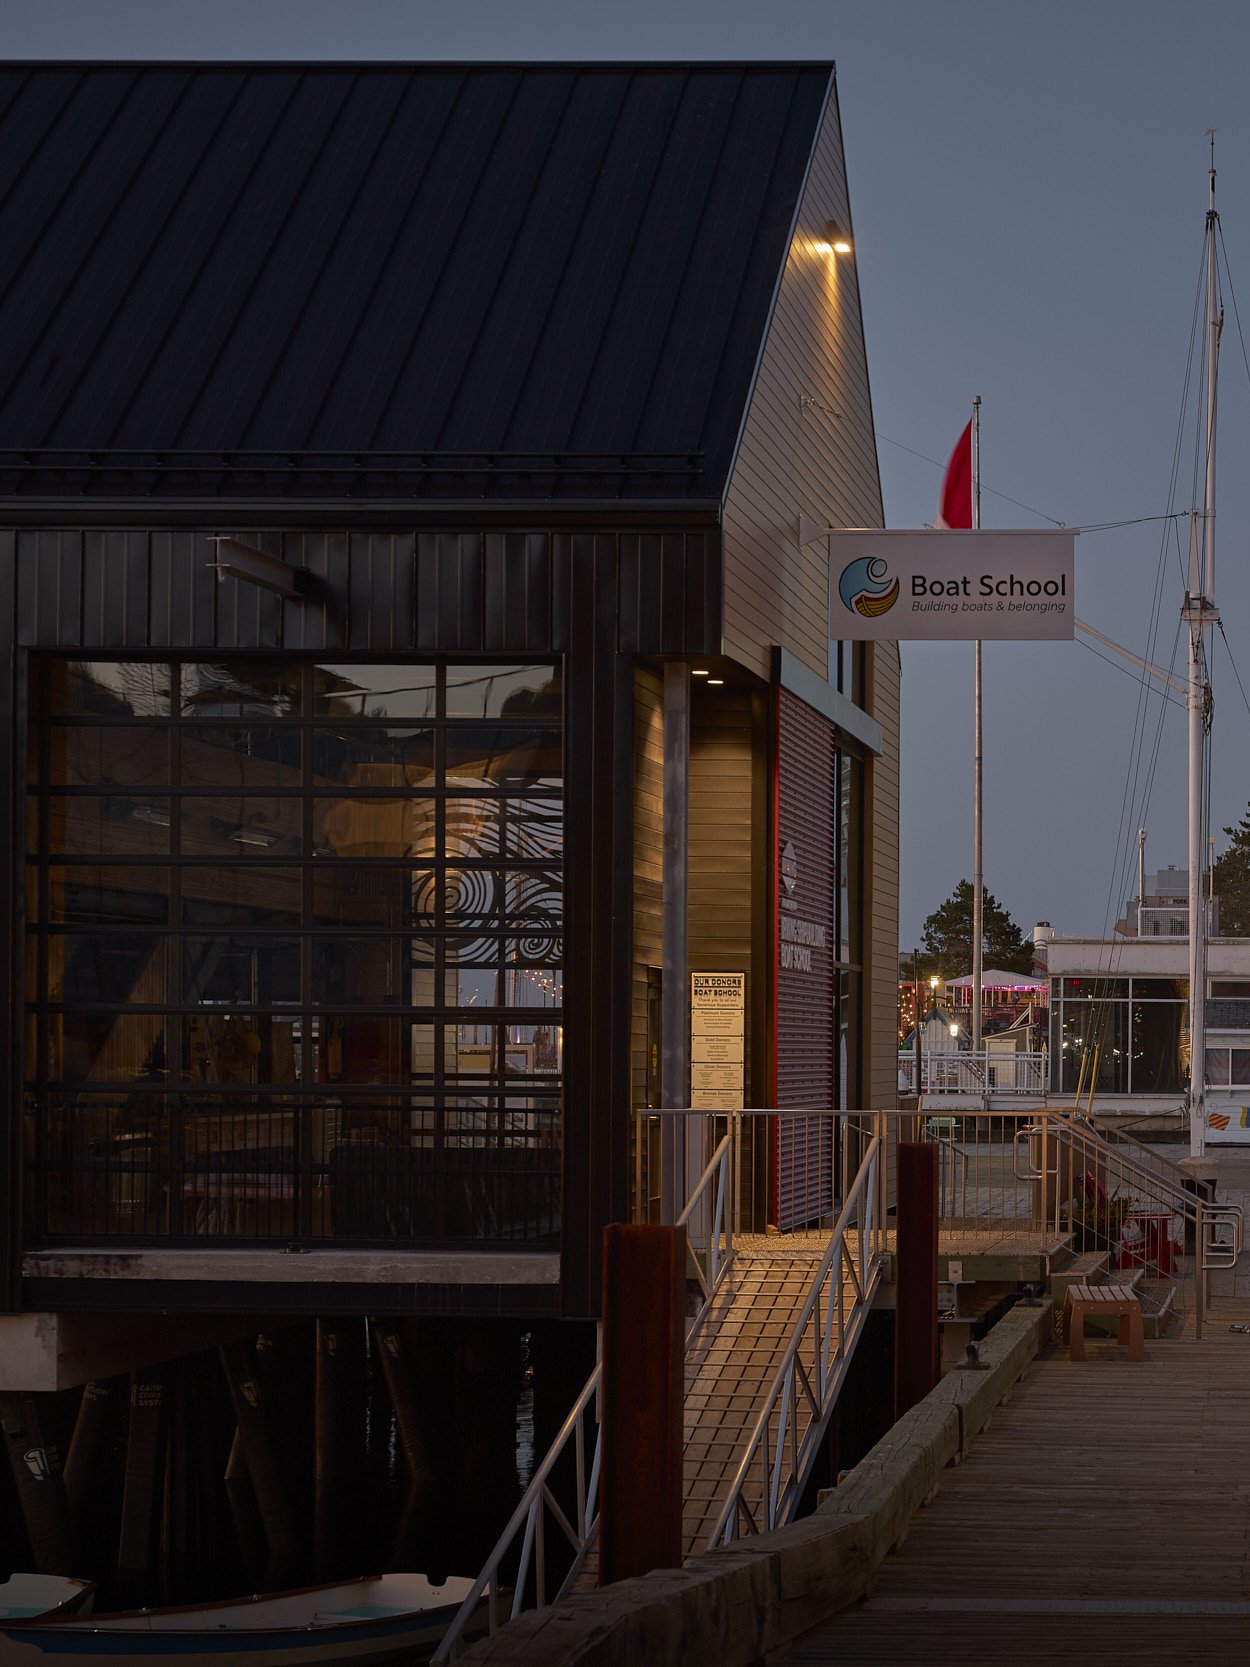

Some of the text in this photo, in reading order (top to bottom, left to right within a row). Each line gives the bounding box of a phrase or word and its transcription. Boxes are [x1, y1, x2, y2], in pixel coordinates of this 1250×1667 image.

[911, 574, 1066, 597] Boat School
[911, 601, 1066, 613] Building boats & belonging
